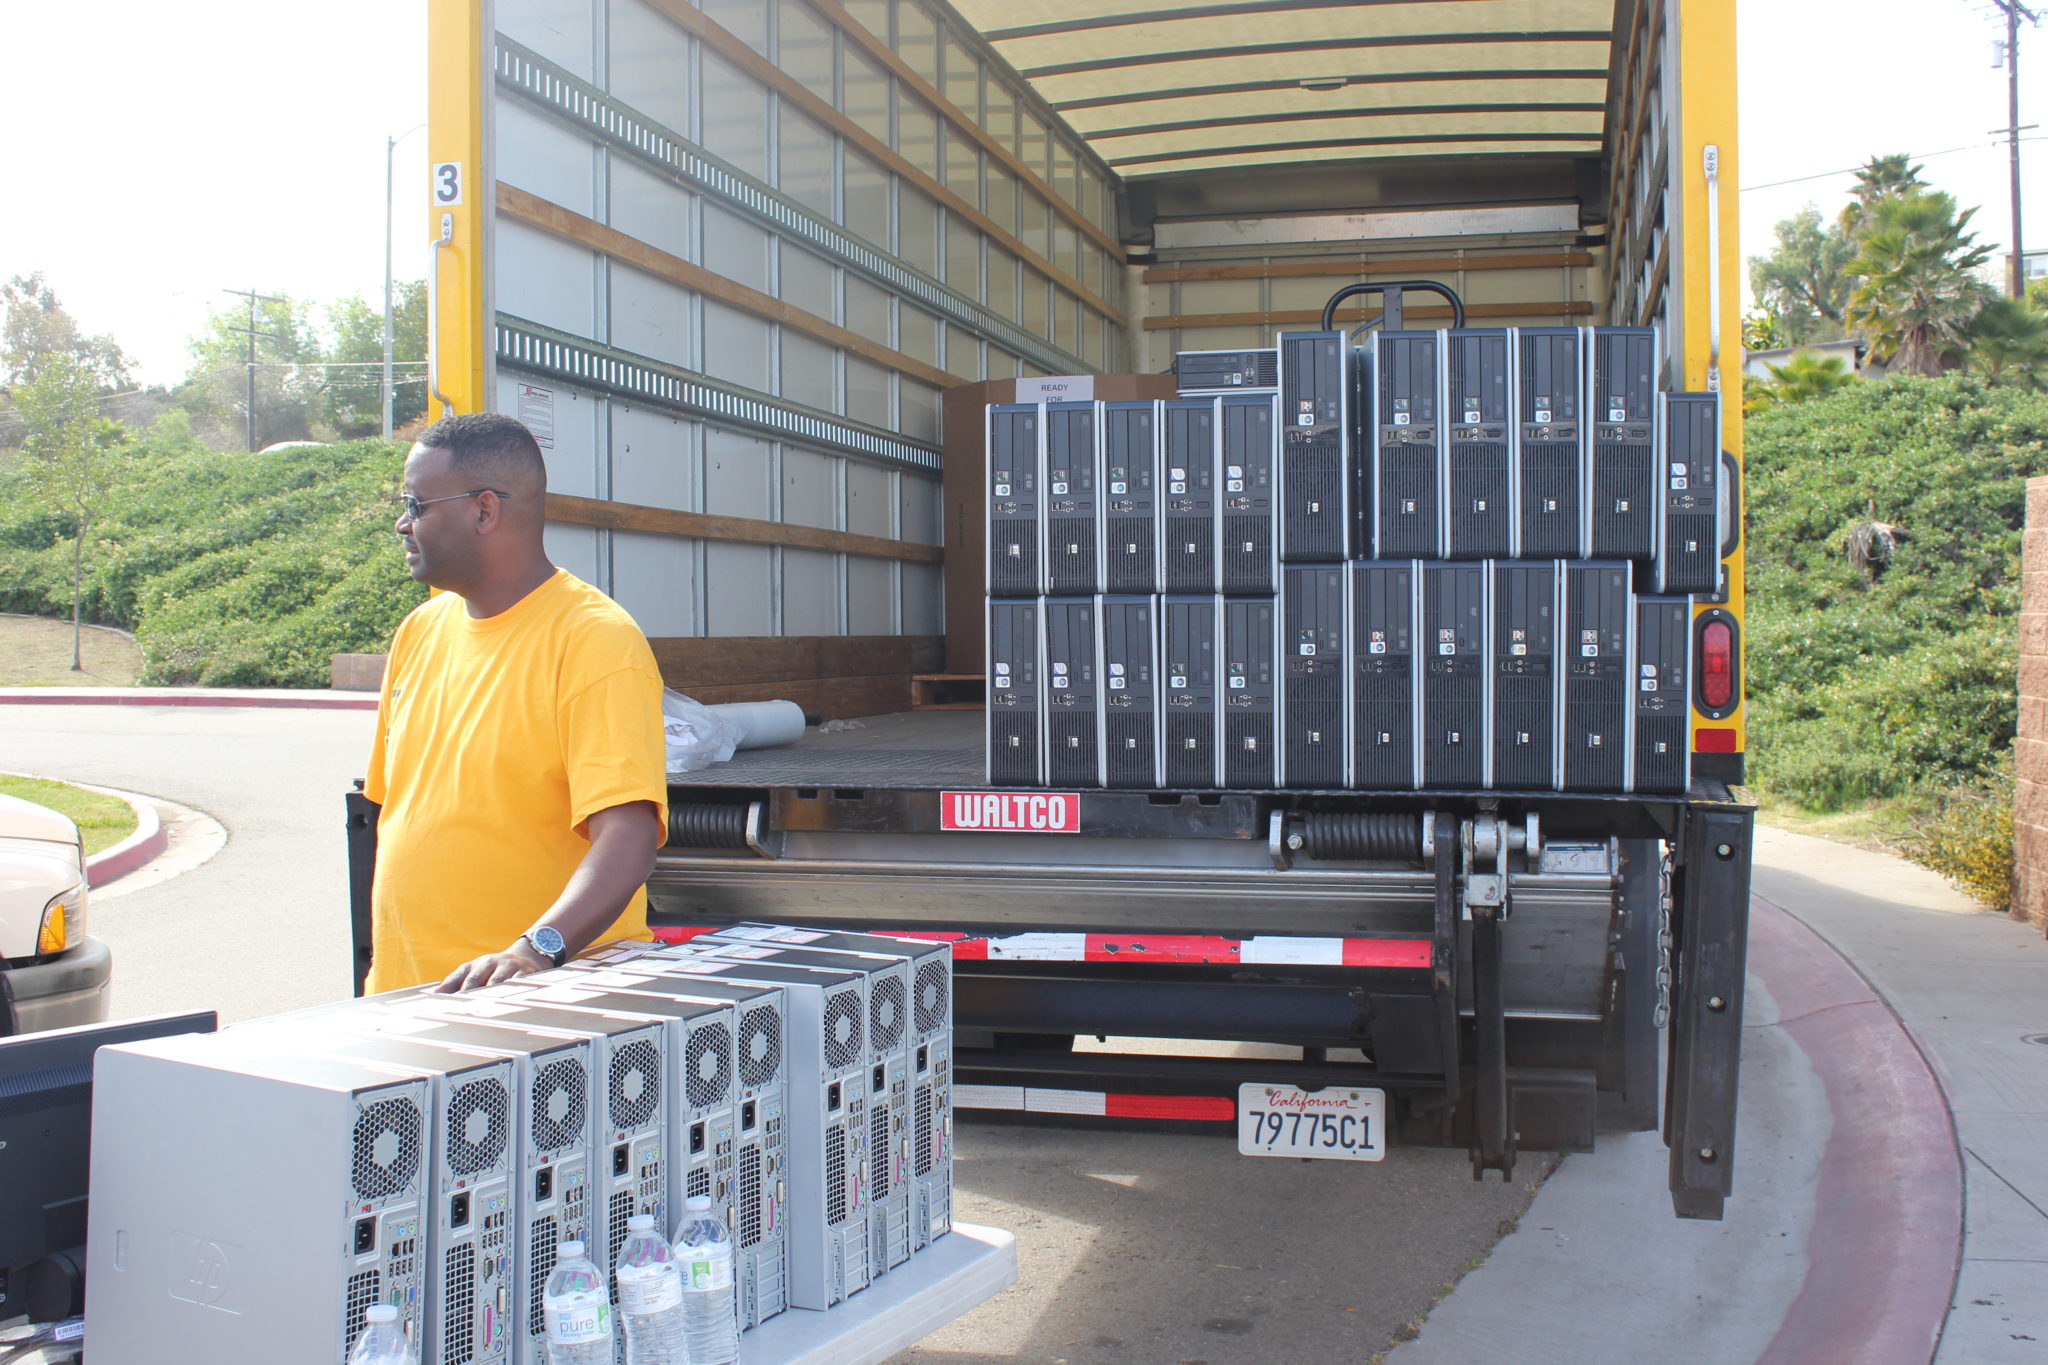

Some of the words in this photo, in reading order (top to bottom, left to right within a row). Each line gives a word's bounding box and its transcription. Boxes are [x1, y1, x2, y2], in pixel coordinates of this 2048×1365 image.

[437, 164, 459, 202] 3
[954, 794, 1066, 829] WALTCO
[1269, 1090, 1358, 1113] California
[1249, 1110, 1374, 1150] 79775C1
[560, 1318, 594, 1336] pure
